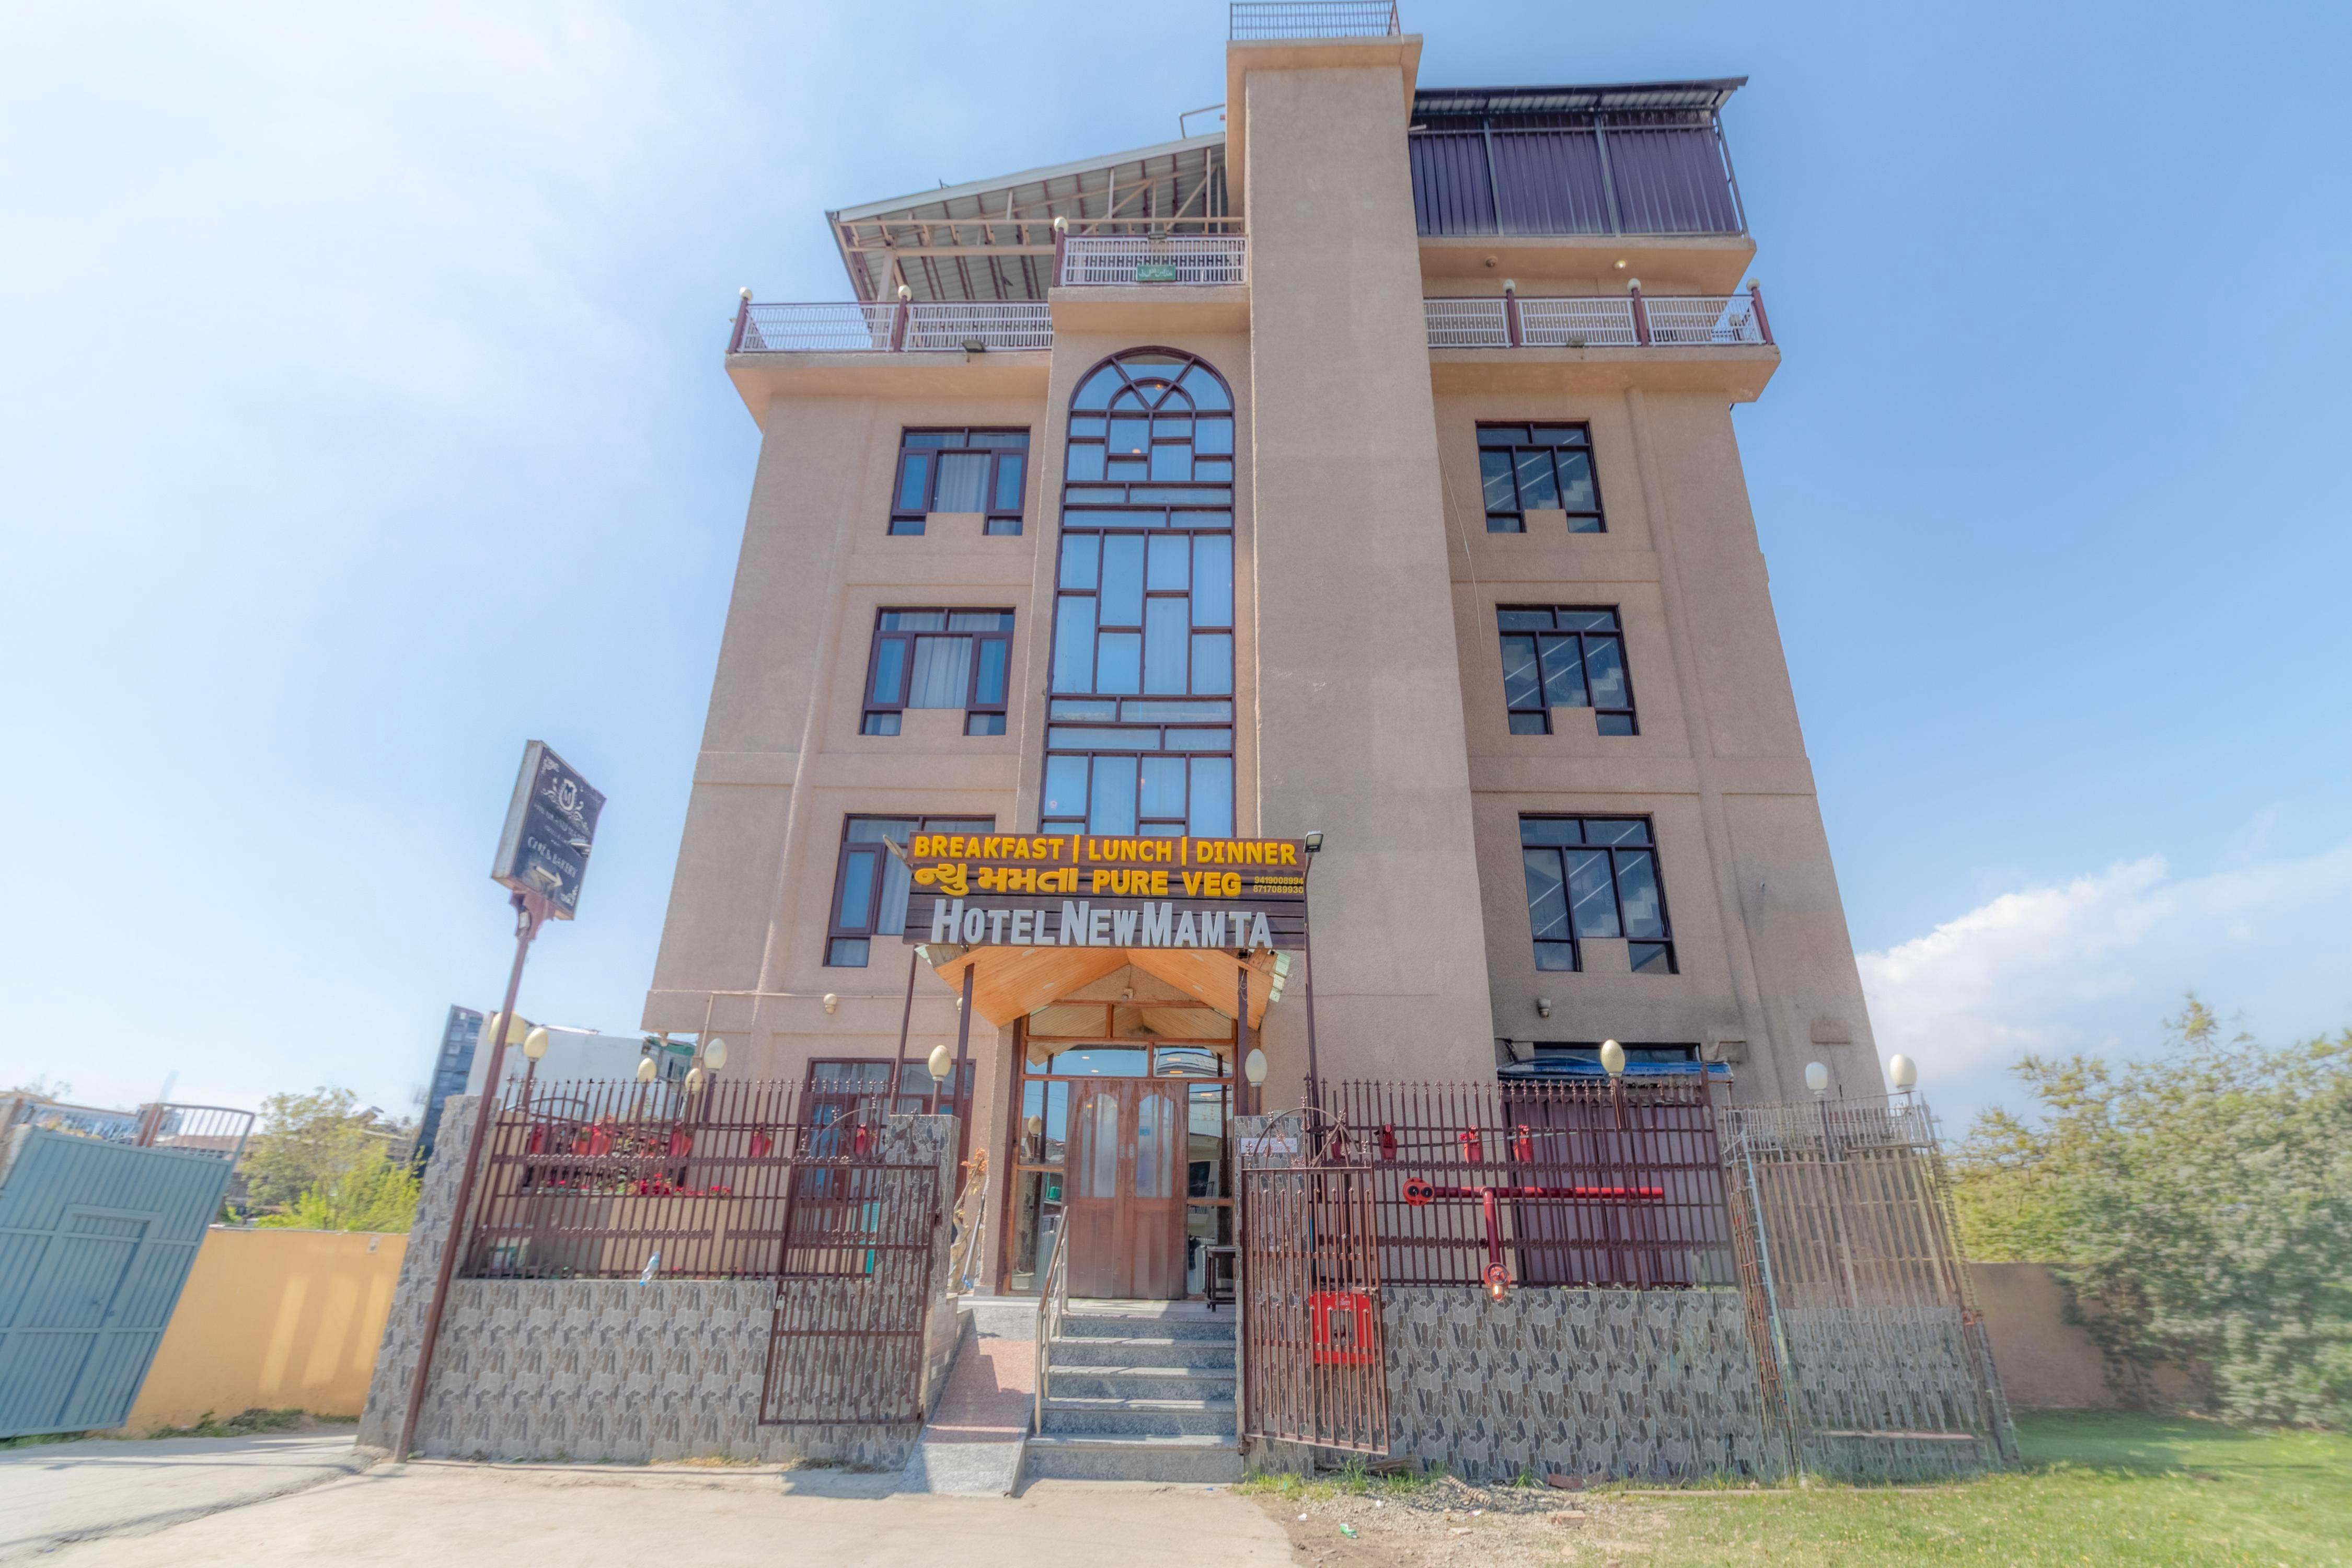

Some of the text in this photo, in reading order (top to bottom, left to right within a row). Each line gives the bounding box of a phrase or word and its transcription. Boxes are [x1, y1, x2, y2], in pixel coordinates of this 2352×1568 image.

[913, 834, 1065, 860] BREAKFAST
[1087, 838, 1173, 862] LUNCH
[1195, 839, 1297, 866] DINNER
[978, 867, 1079, 893] મમતા
[1091, 869, 1242, 897] PURE VEG
[1254, 876, 1304, 884] 9419008994
[930, 898, 1055, 946] HOTEL
